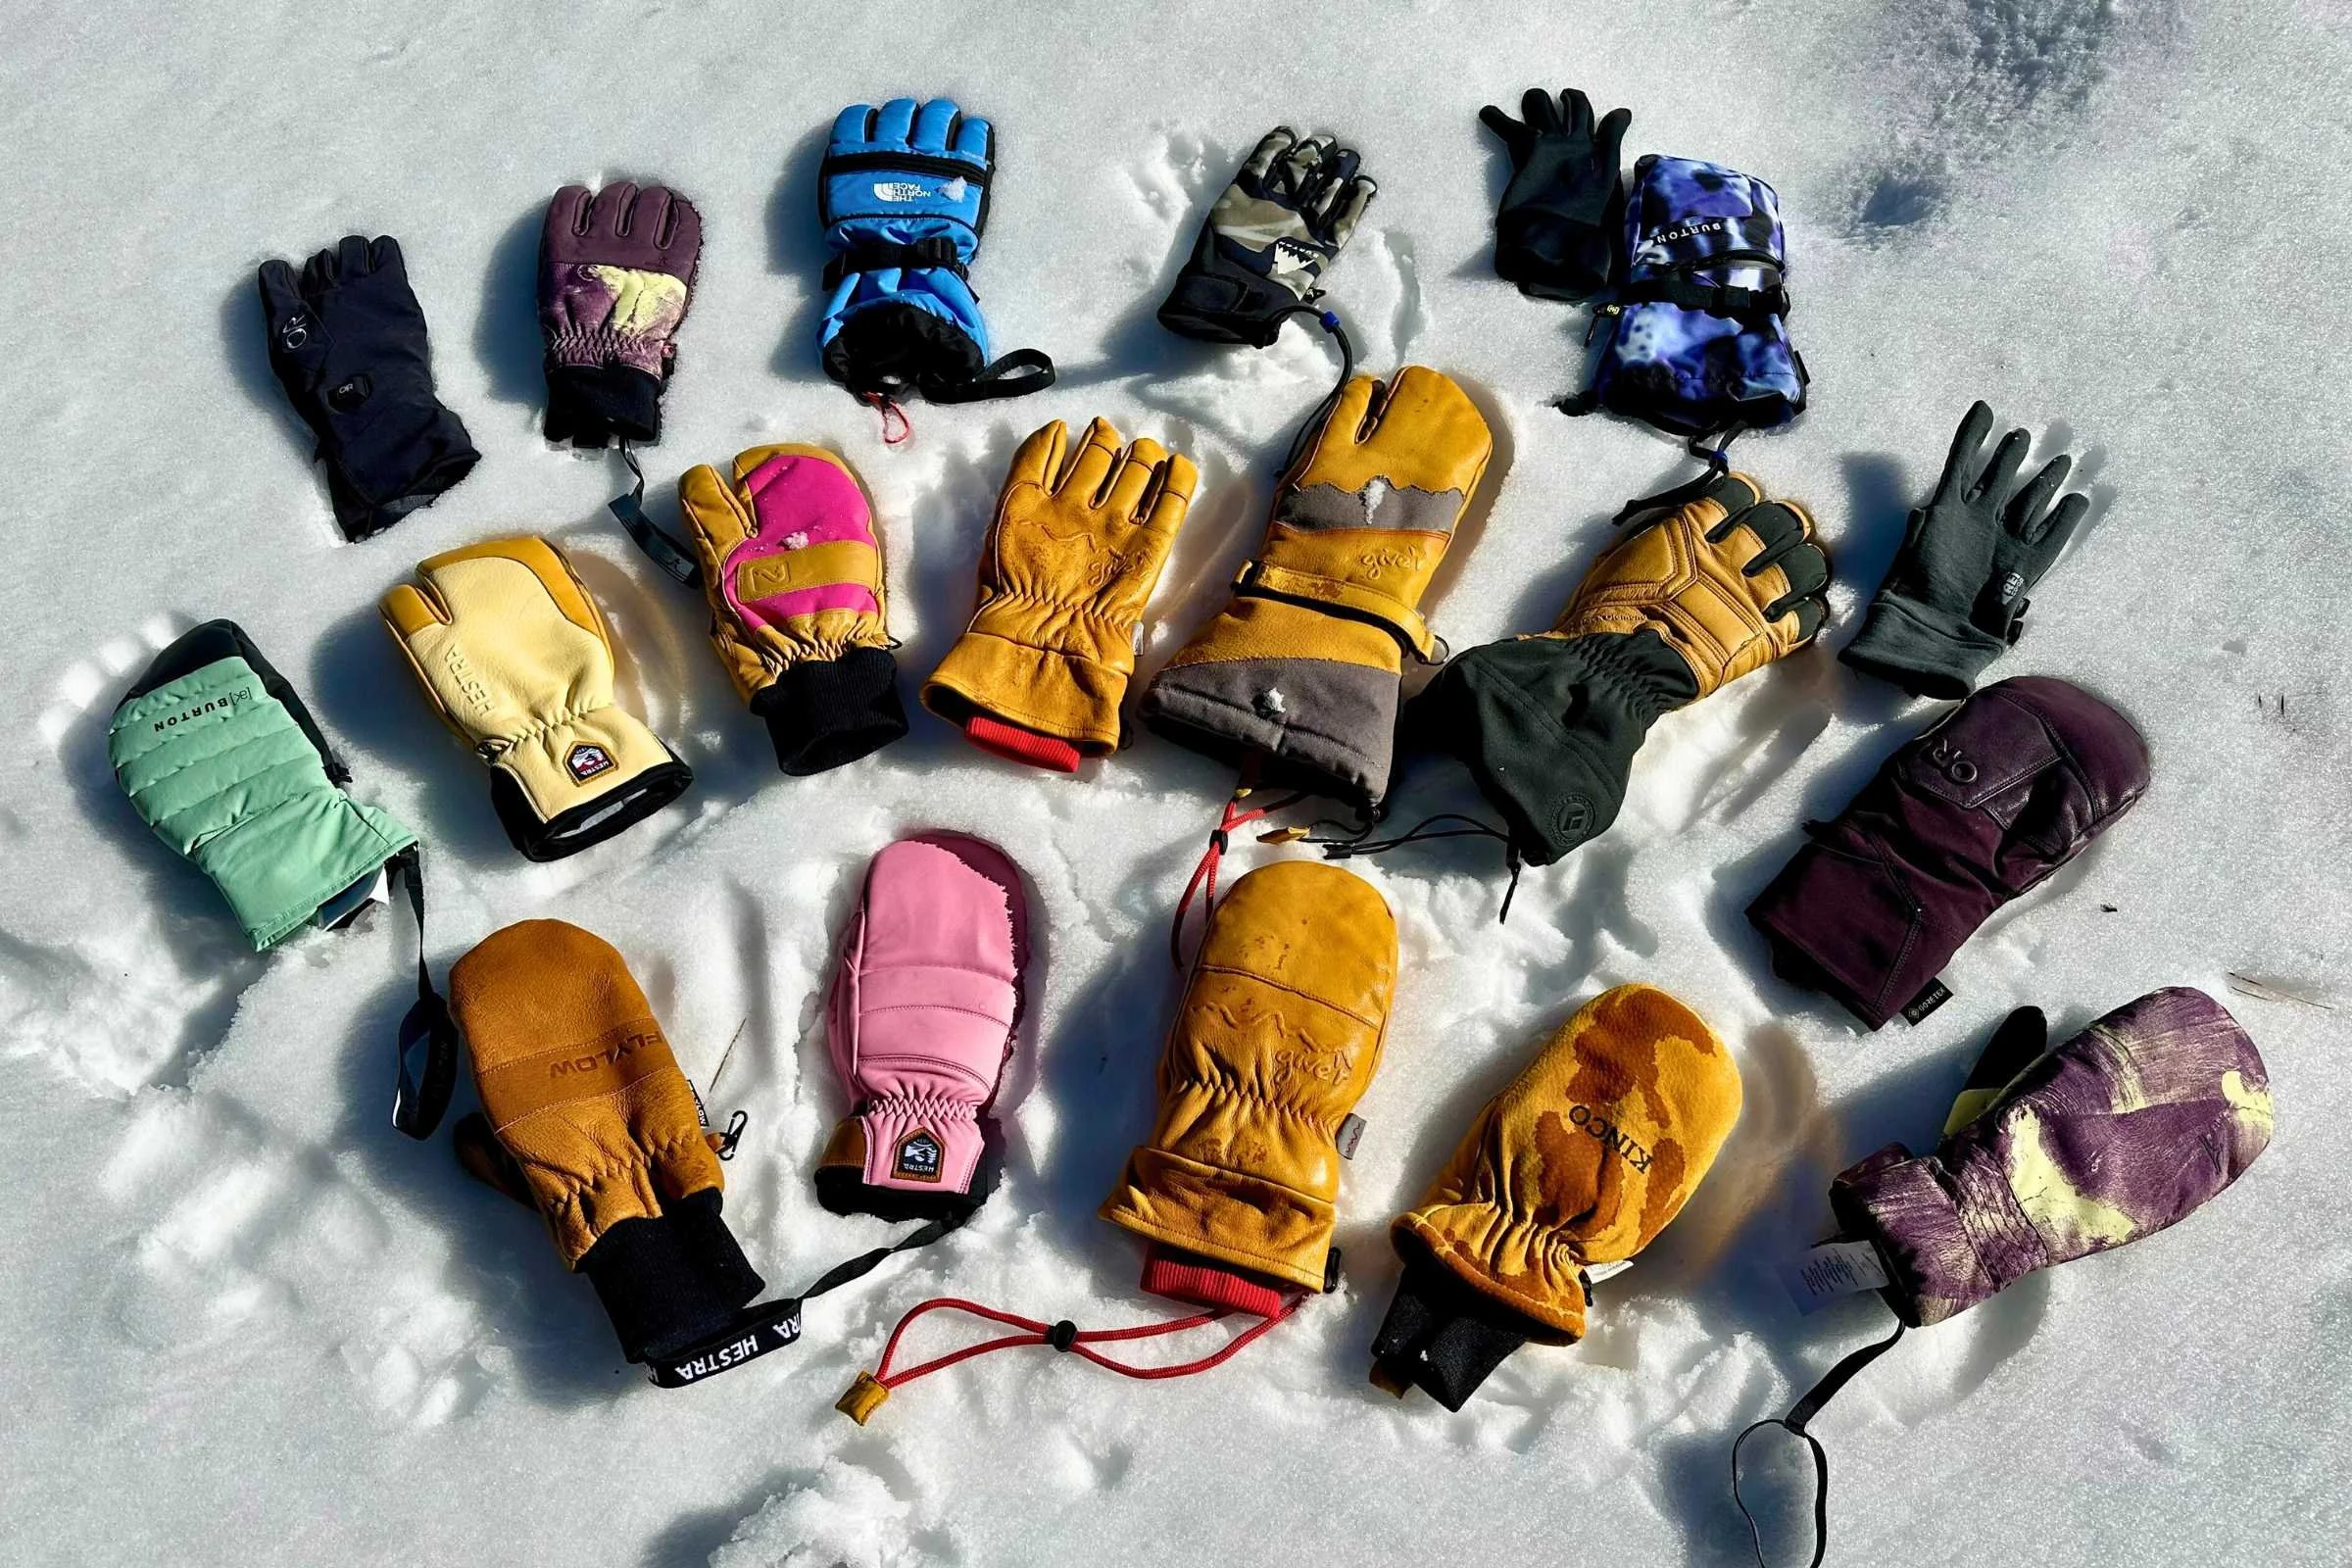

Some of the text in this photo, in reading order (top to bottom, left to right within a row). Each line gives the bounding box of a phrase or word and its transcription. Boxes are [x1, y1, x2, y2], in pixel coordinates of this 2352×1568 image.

[893, 182, 921, 191] FACE
[893, 189, 932, 198] NORTH
[1656, 221, 1722, 244] BURTON
[444, 642, 496, 718] HESTRA
[154, 697, 229, 732] BURTON
[579, 760, 610, 776] HESTRA
[549, 1030, 665, 1079] FLYLOW
[1569, 1104, 1654, 1174] KINCO
[903, 1162, 936, 1173] HESTRA
[673, 1334, 760, 1381] HESTRA
